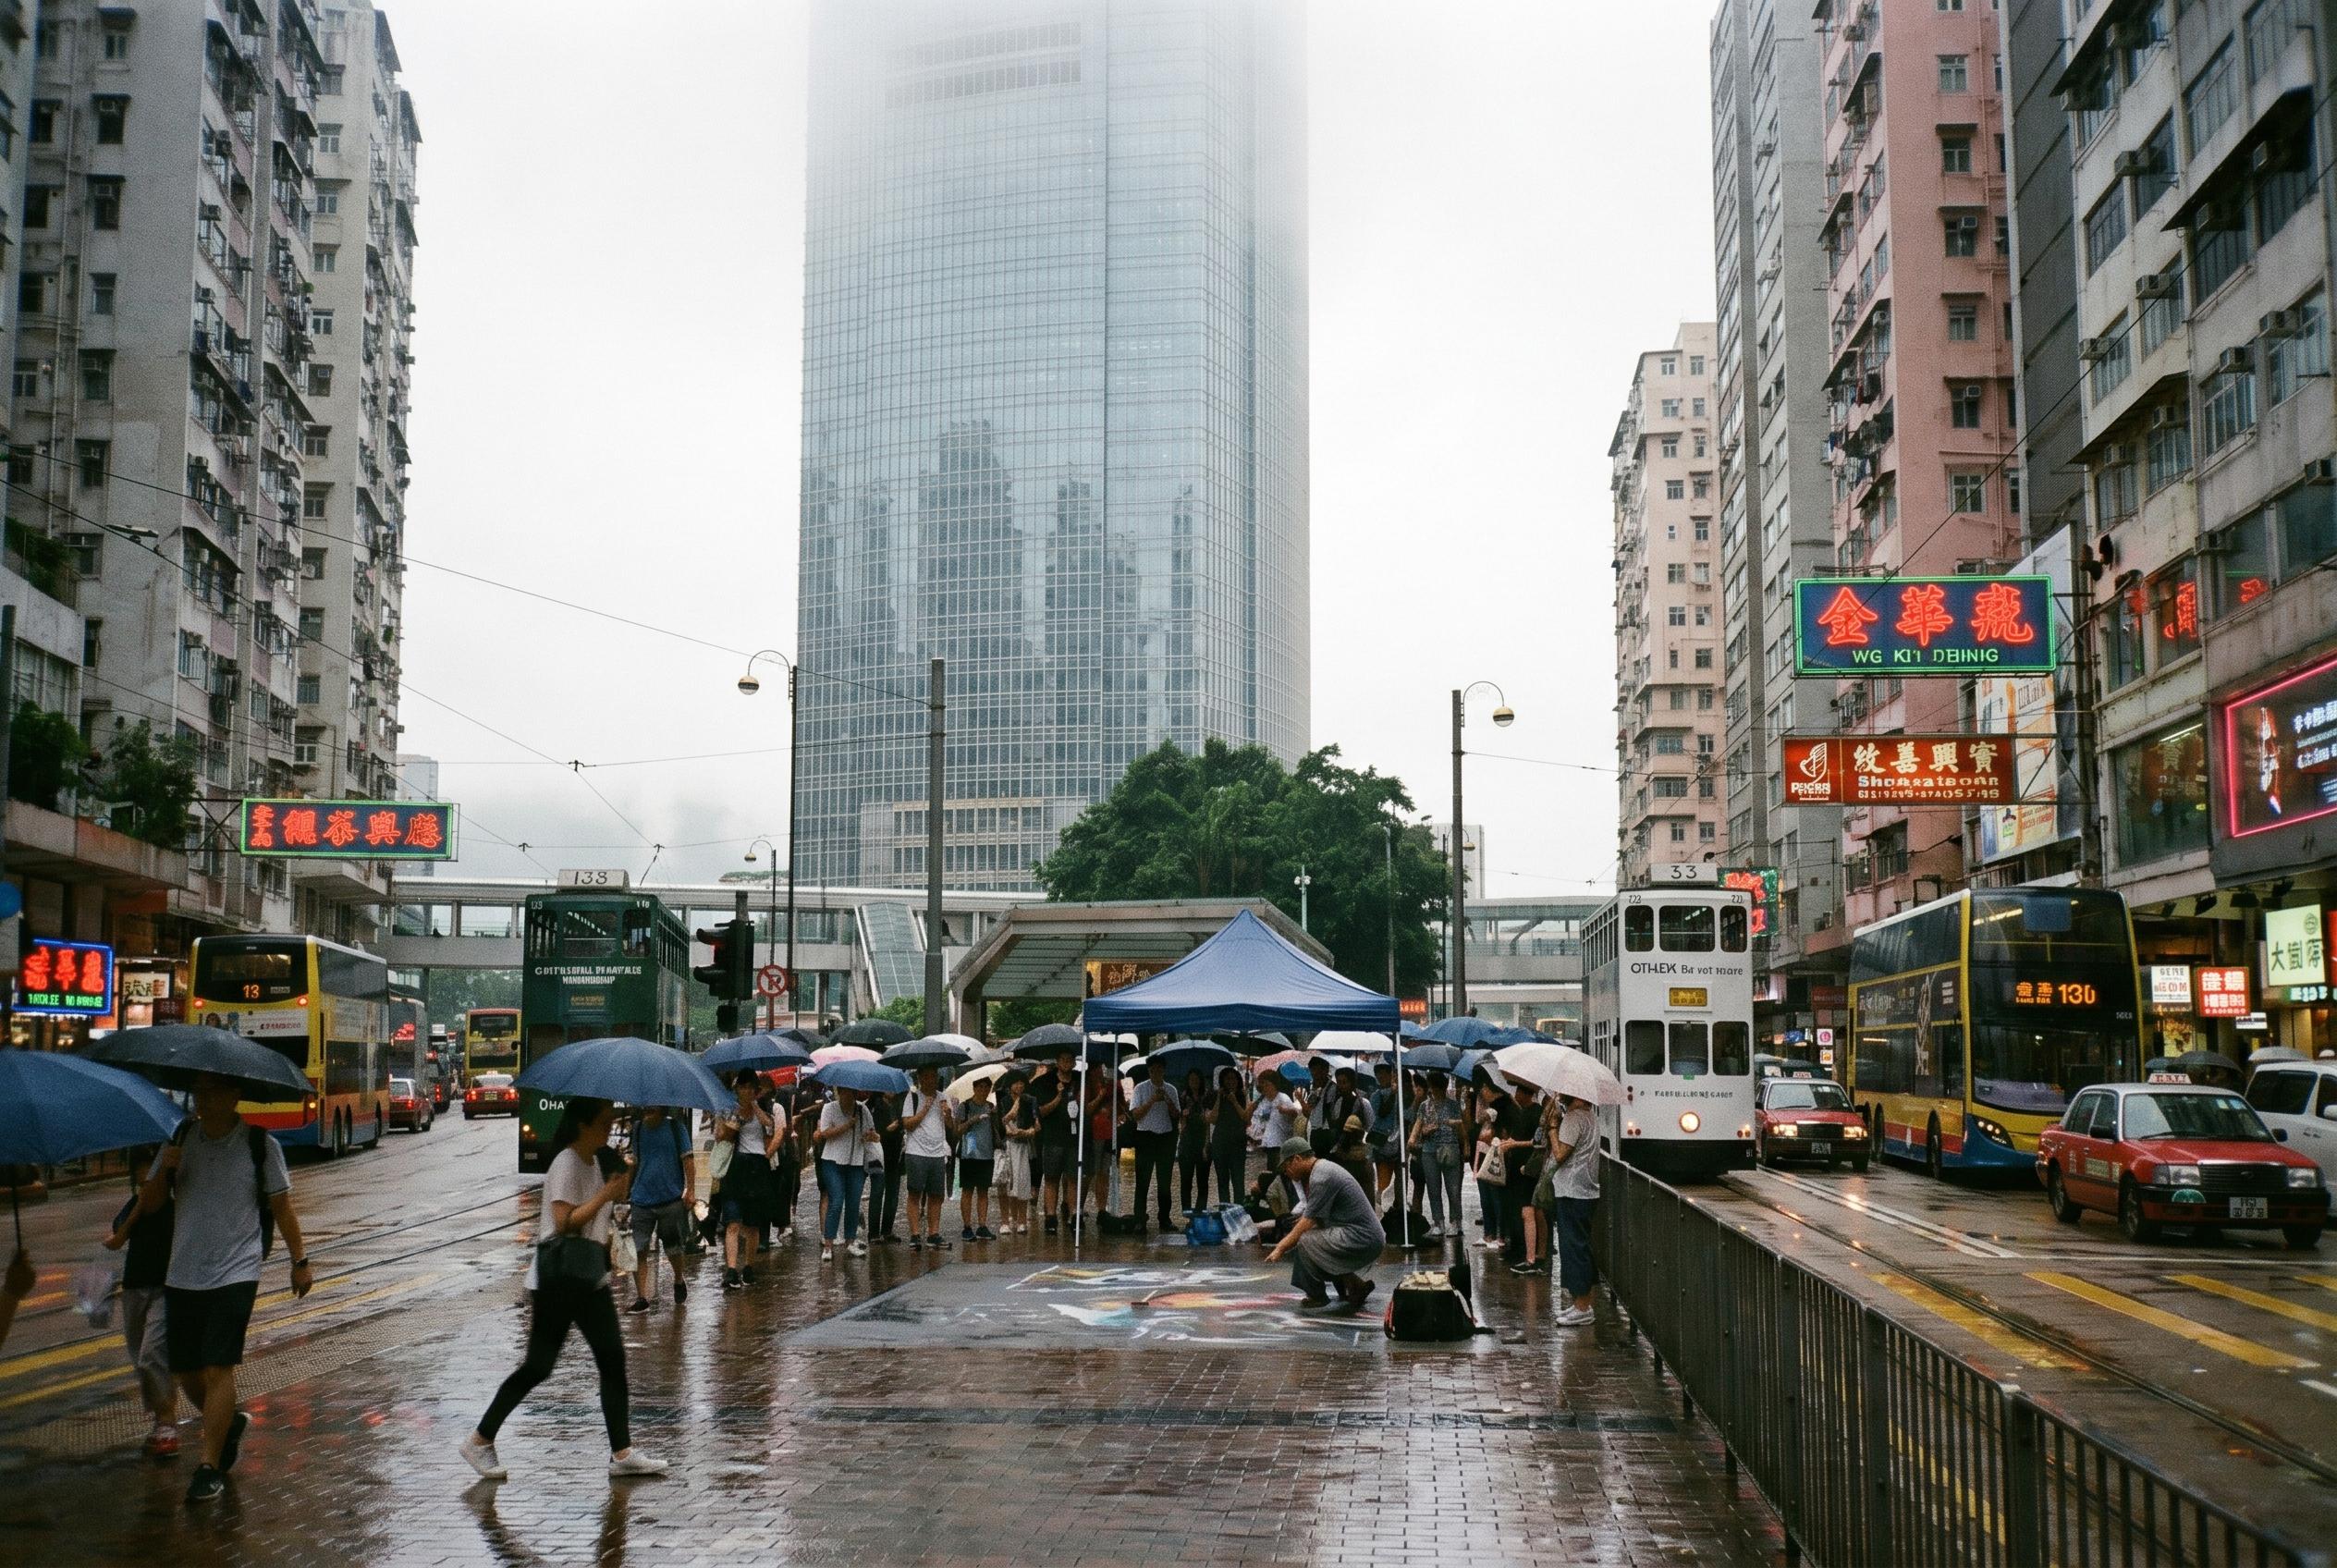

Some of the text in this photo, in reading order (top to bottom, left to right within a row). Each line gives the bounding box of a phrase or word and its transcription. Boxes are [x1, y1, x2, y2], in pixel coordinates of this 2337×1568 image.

[573, 871, 608, 885] 138
[1670, 864, 1697, 879] 33
[243, 985, 260, 998] 13
